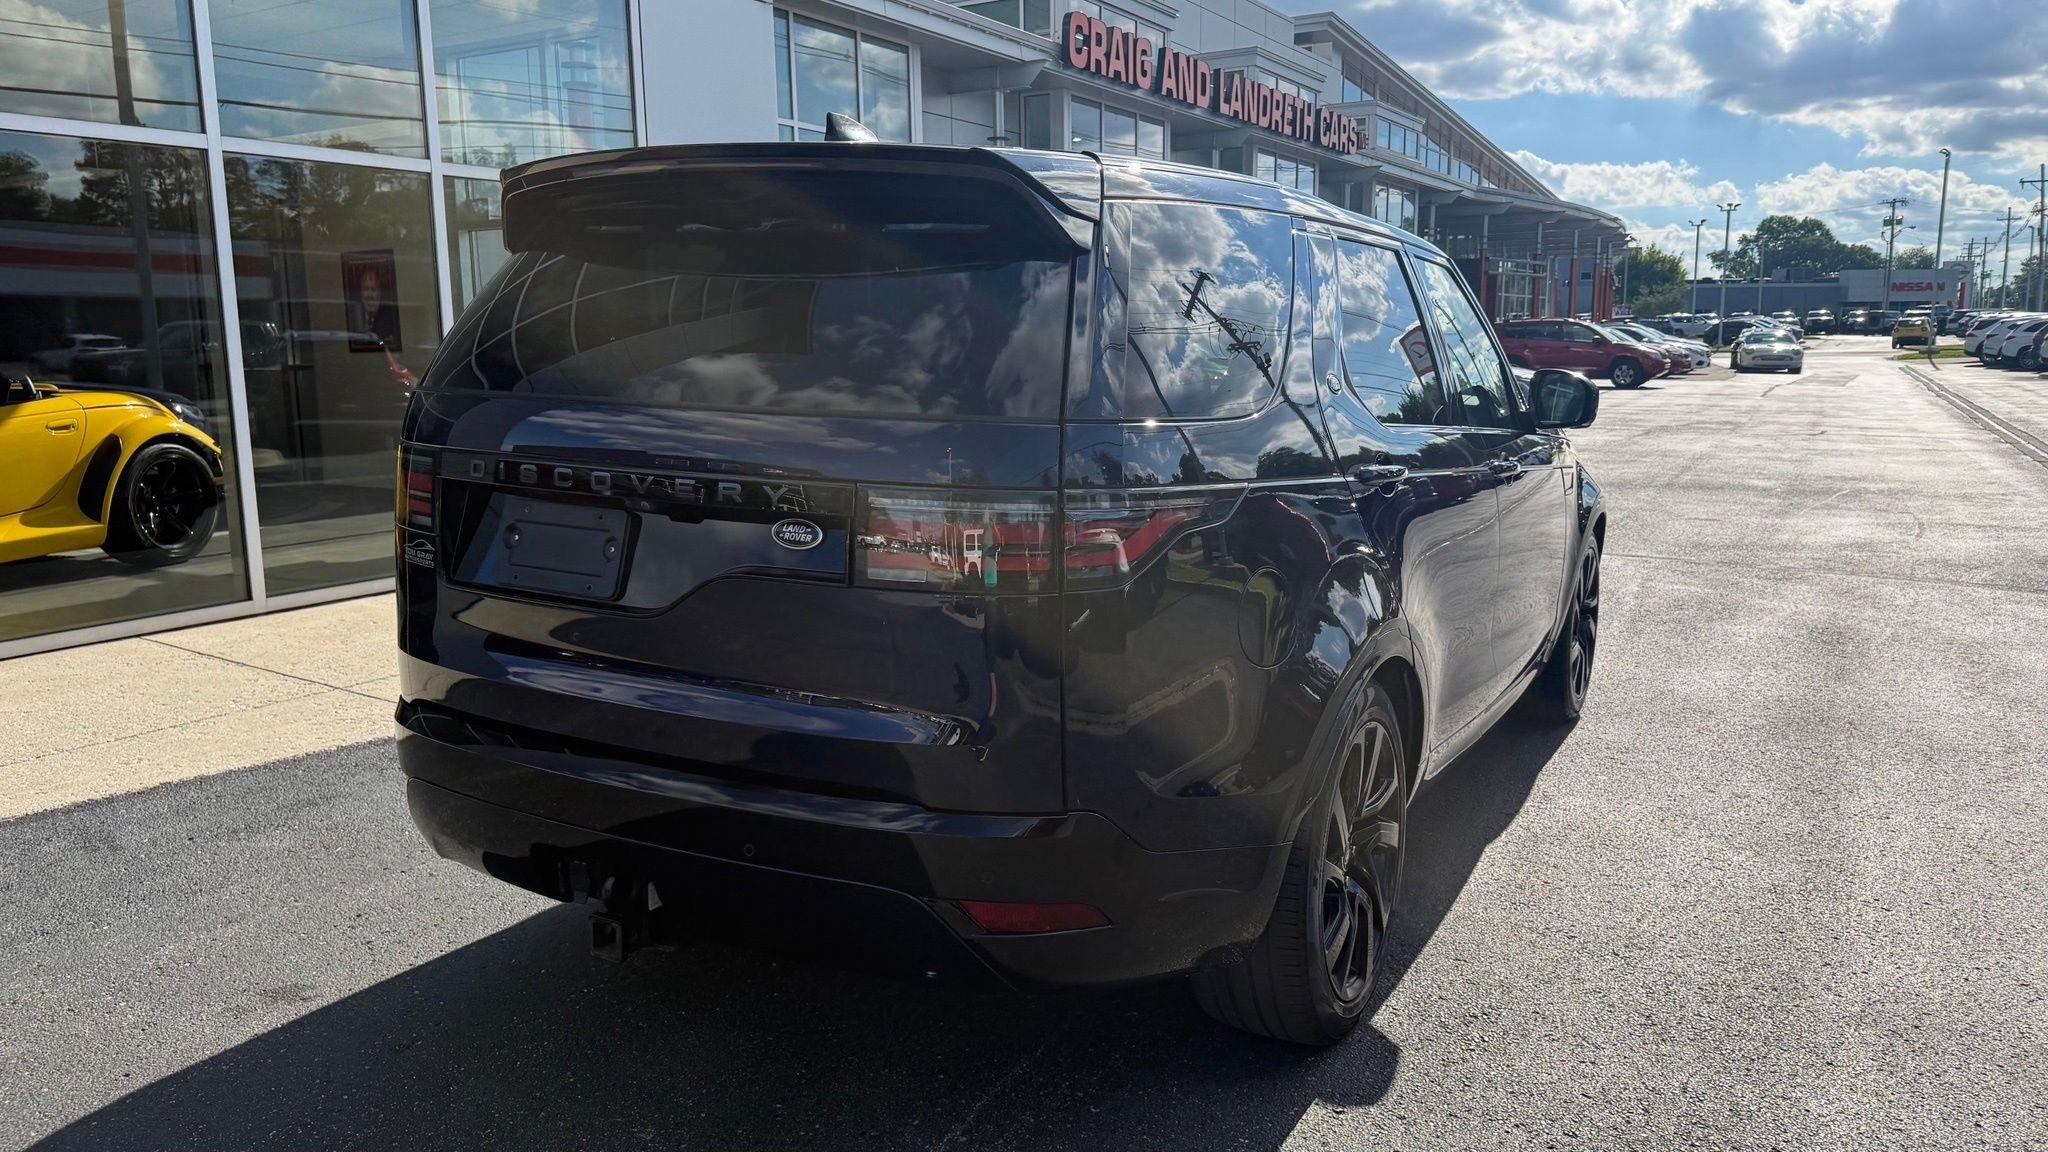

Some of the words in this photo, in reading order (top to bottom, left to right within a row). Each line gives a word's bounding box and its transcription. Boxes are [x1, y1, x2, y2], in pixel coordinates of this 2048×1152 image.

[1064, 11, 1152, 90] CRAIG
[1160, 48, 1211, 109] AND
[1215, 69, 1315, 142] LANDRETH
[1317, 106, 1358, 155] CARS
[1891, 281, 1946, 291] NISSAN
[470, 459, 789, 506] DISCOVERY
[782, 524, 806, 533] LAND
[783, 532, 813, 543] ROVER
